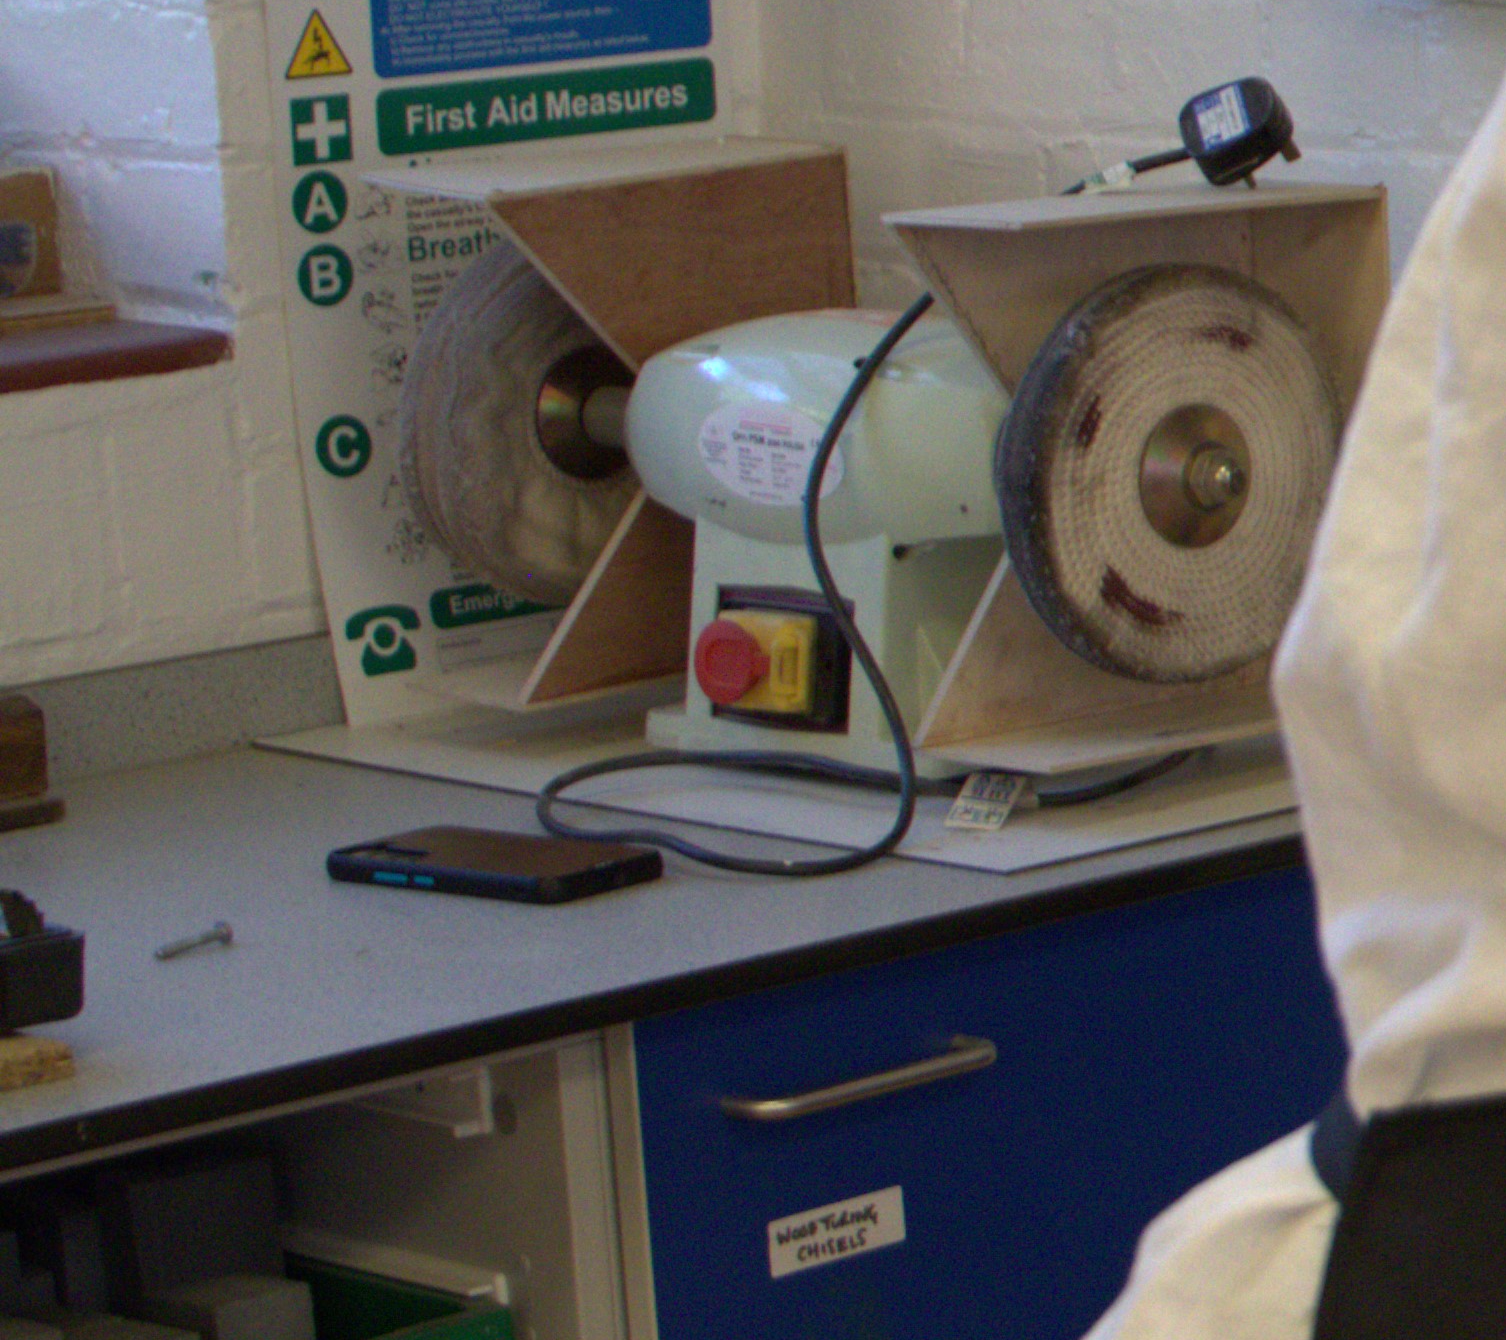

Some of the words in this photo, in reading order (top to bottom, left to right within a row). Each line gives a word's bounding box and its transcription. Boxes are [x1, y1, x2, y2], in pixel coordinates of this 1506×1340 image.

[406, 103, 475, 135] First
[487, 94, 538, 128] Aid
[545, 84, 689, 121] Measures
[303, 182, 339, 225] A
[408, 228, 500, 261] Breath
[309, 255, 341, 298] B
[327, 426, 361, 468] C
[449, 590, 516, 614] Emerg
[776, 1221, 818, 1247] WOOD
[798, 1227, 867, 1262] CHISELS
